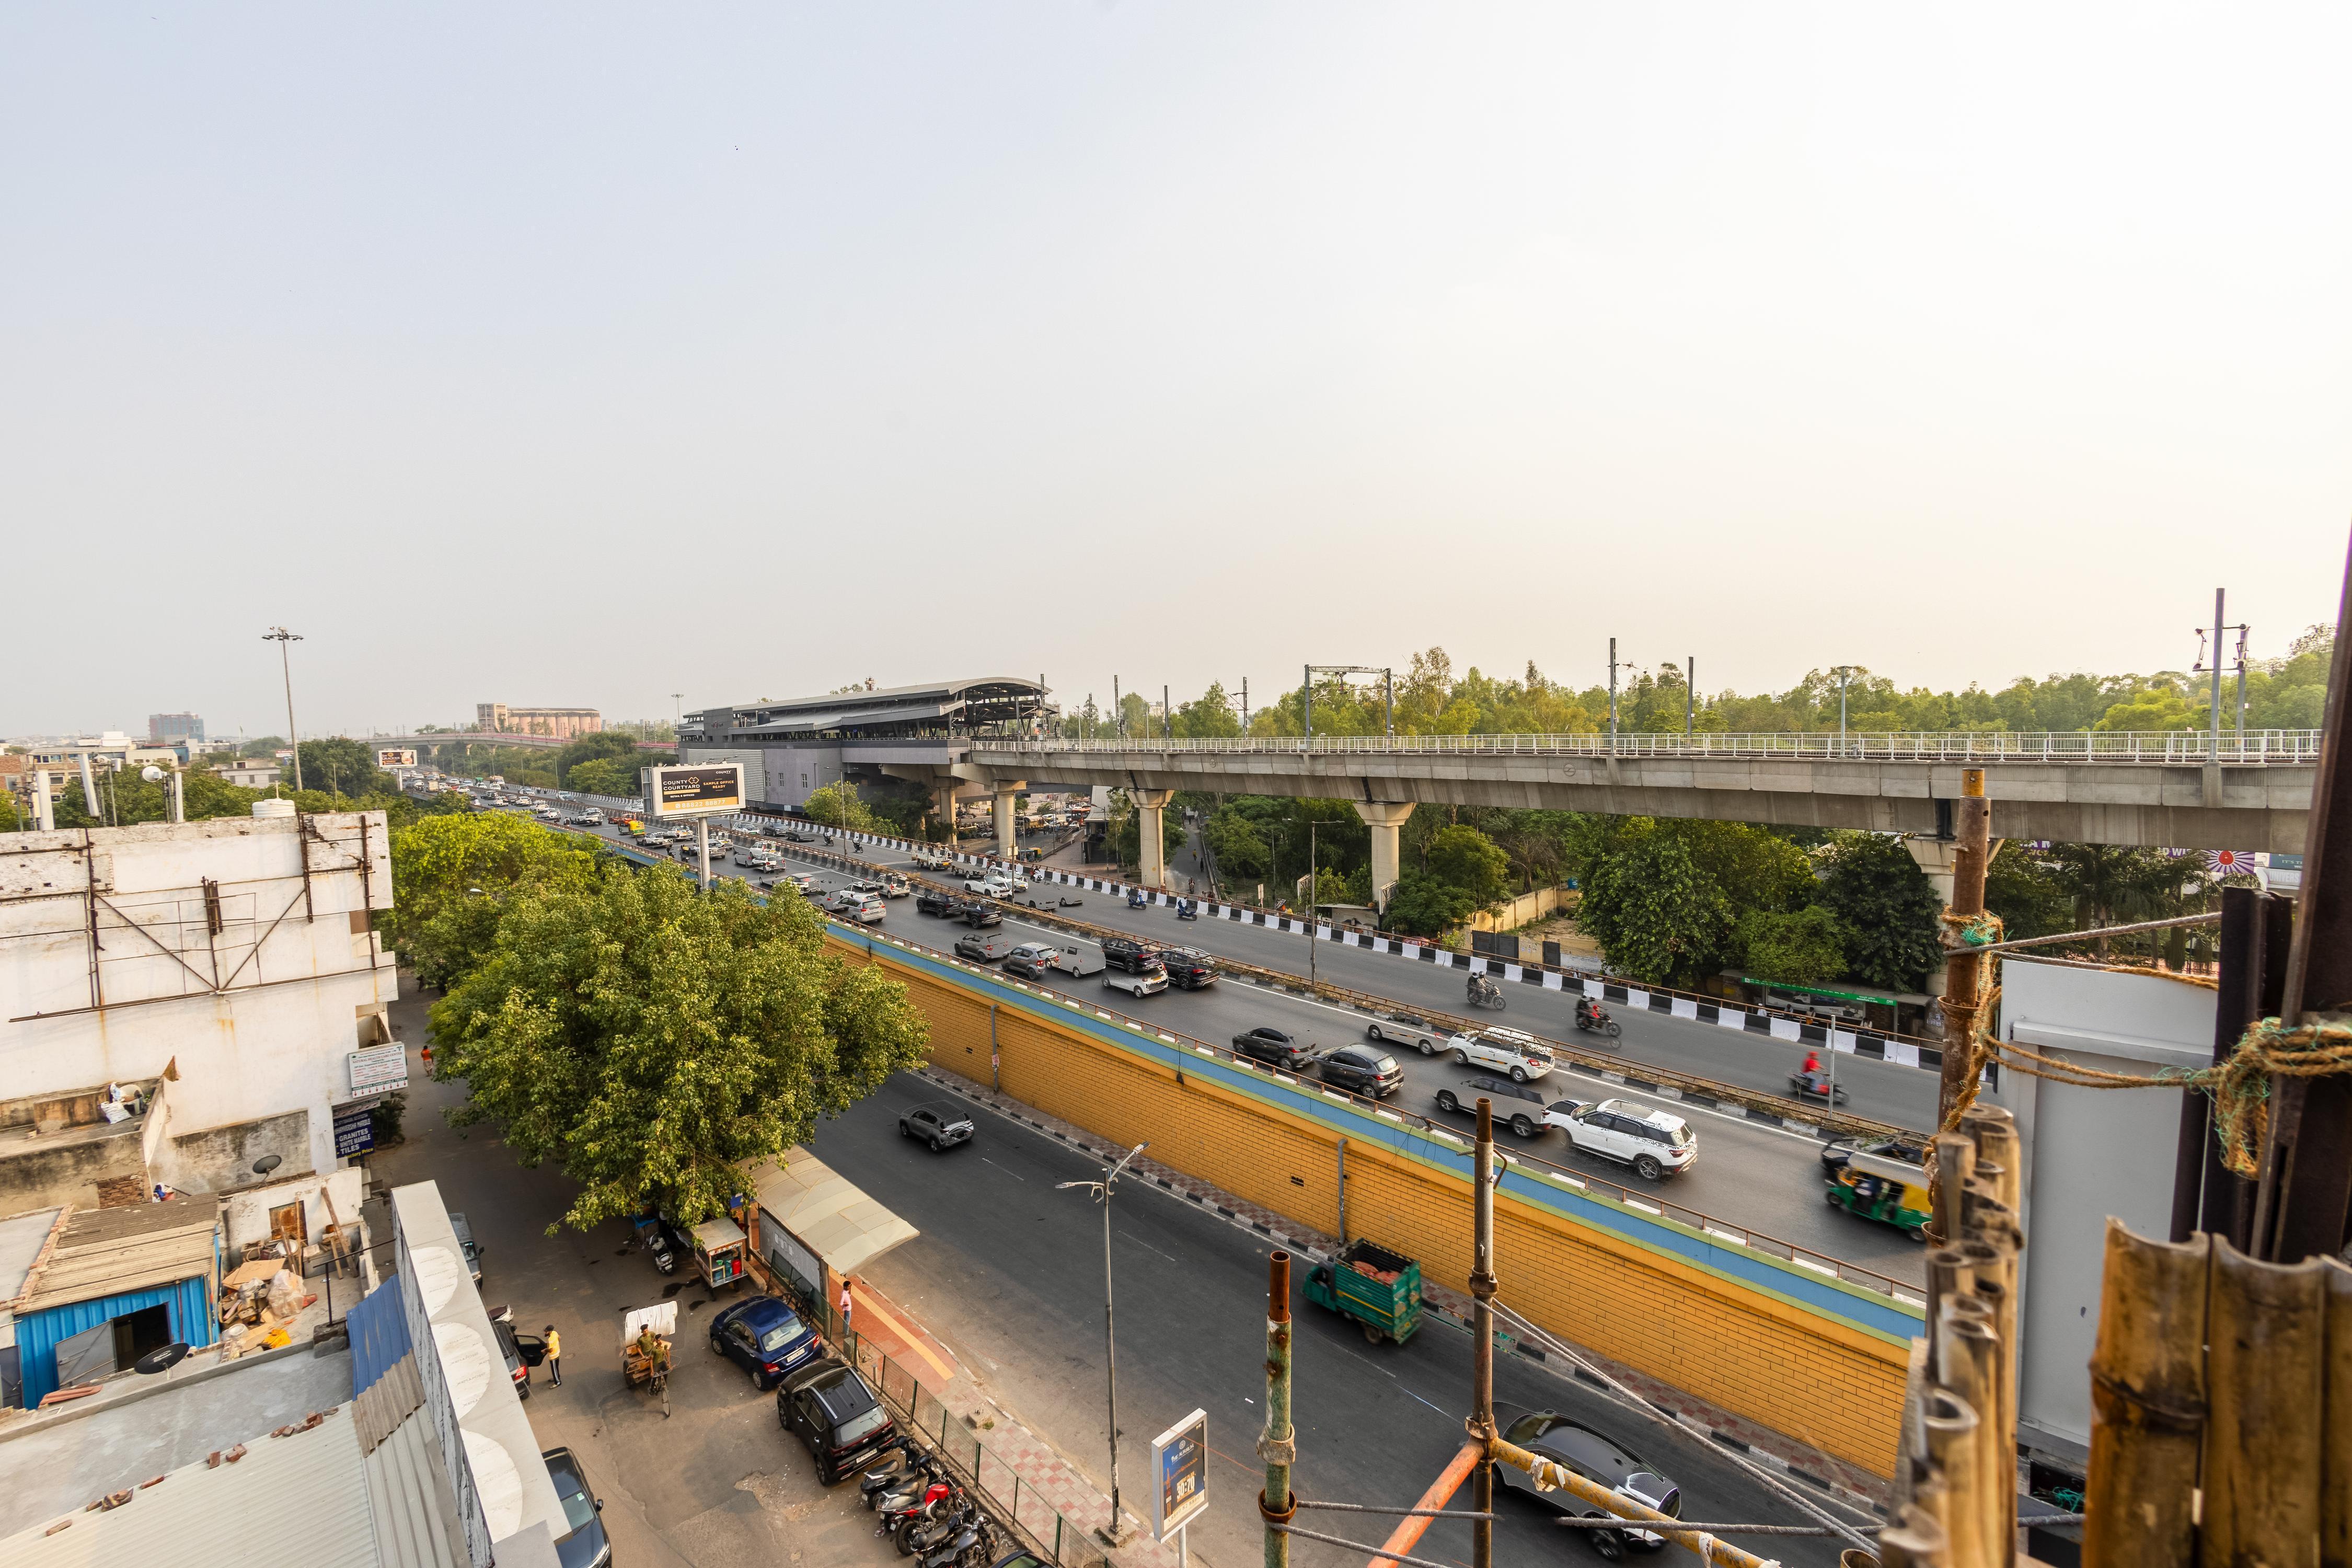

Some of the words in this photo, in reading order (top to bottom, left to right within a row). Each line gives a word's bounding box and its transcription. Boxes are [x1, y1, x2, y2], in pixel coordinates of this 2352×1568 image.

[339, 1128, 368, 1142] GRANITES
[340, 1139, 353, 1148] WHITE
[354, 1134, 371, 1144] MARBLE
[340, 1144, 360, 1155] TILES
[1177, 1476, 1195, 1500] 30:70
